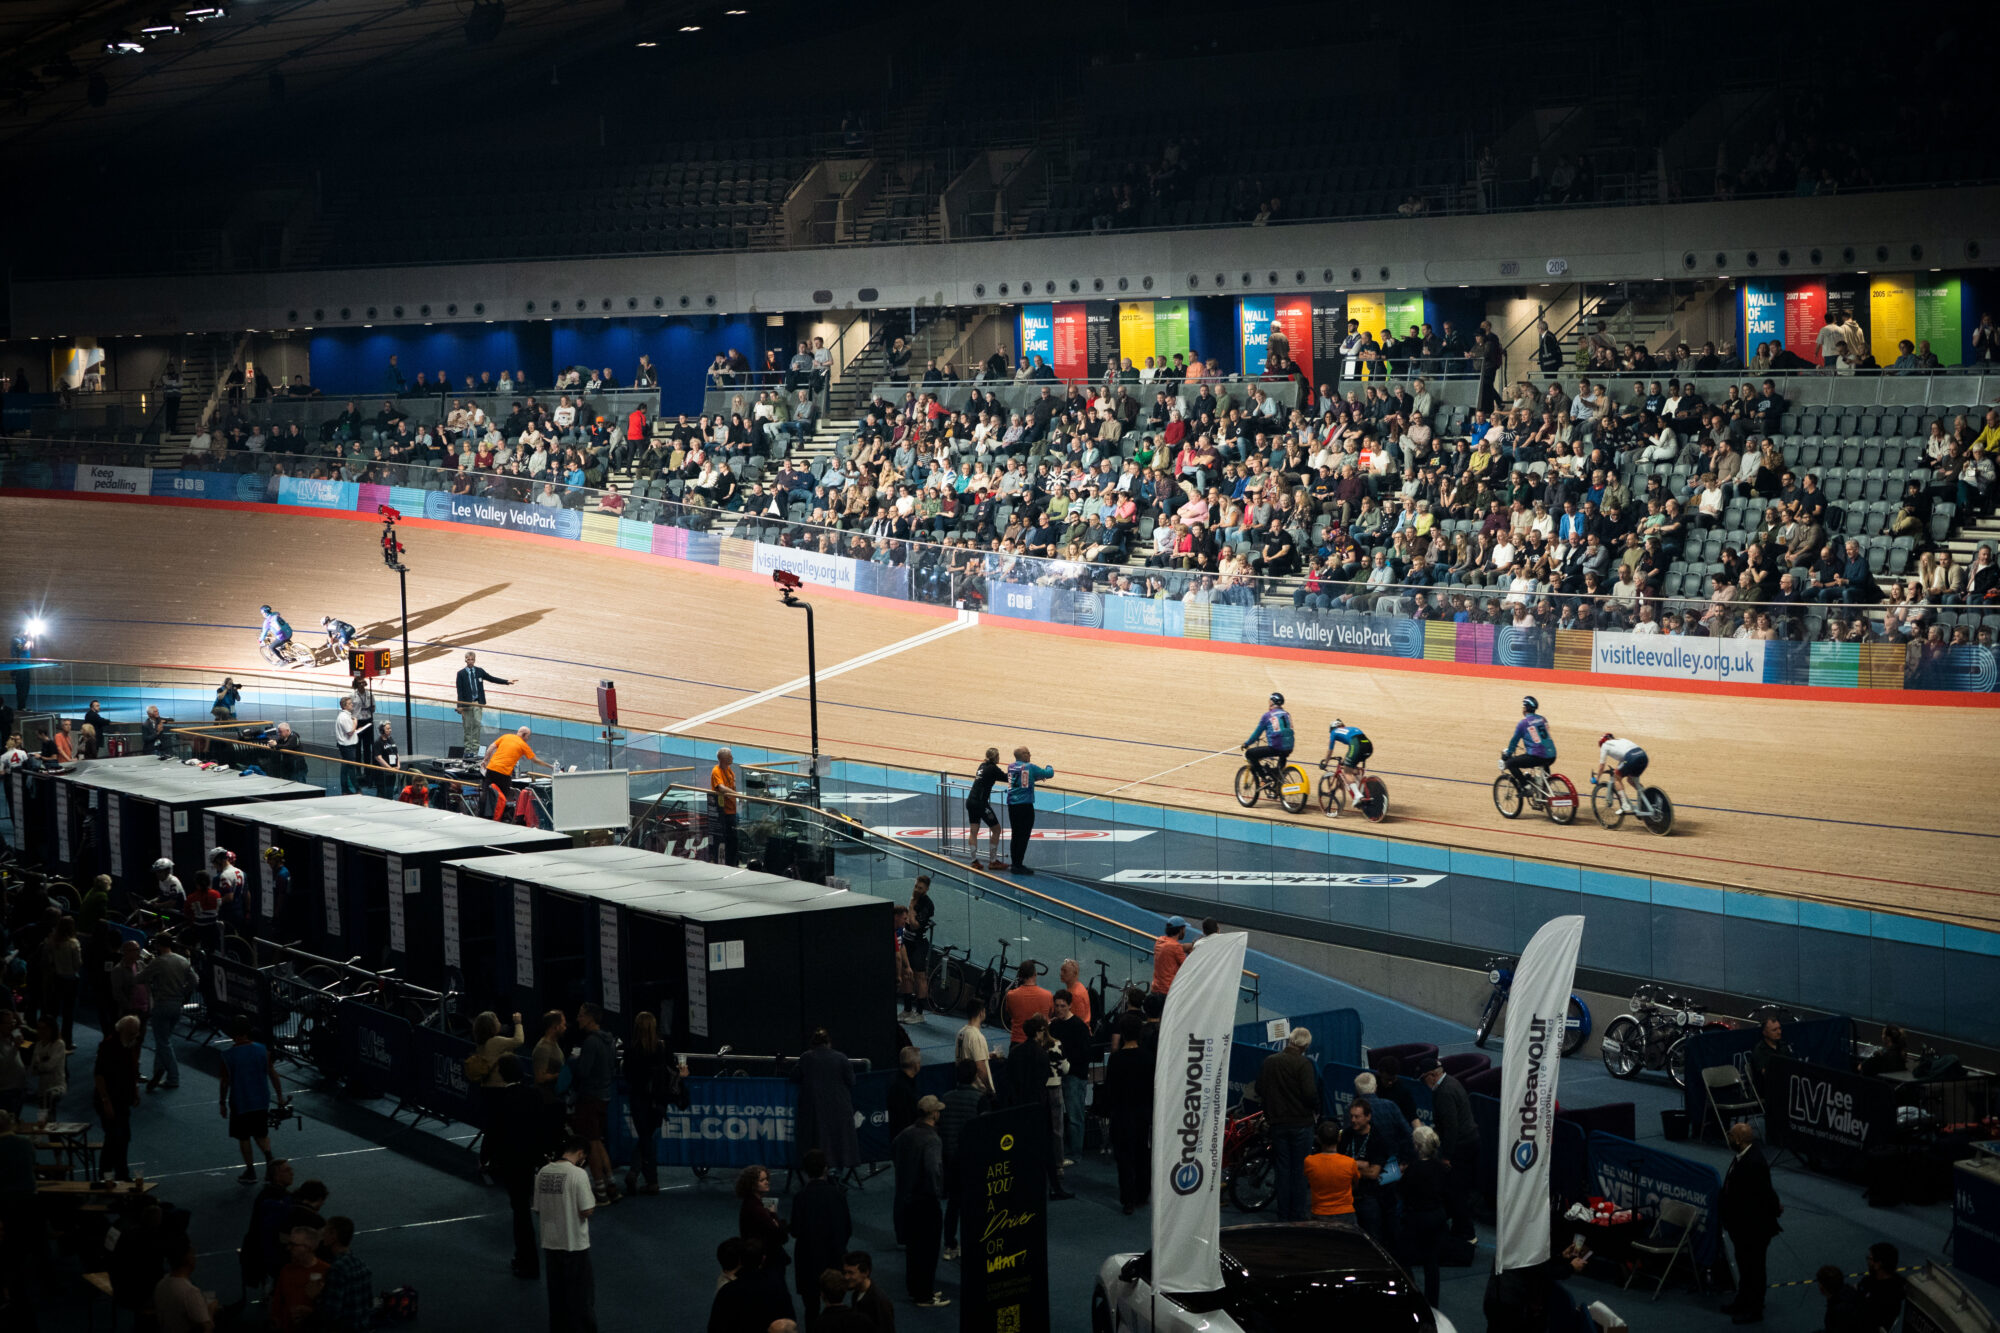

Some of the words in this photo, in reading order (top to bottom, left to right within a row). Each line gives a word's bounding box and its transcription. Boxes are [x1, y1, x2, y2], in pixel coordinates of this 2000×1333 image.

[1501, 263, 1517, 275] 207
[1549, 261, 1566, 273] 208
[1748, 294, 1777, 306] WALL
[1872, 290, 1886, 298] 2005
[1244, 311, 1269, 321] WALL
[1748, 308, 1761, 320] OF
[1024, 318, 1049, 328] WALL
[1244, 323, 1255, 334] OF
[1748, 321, 1776, 334] FAME
[1024, 330, 1036, 340] OF
[1244, 334, 1268, 345] FAME
[1025, 341, 1049, 351] FAME
[91, 467, 114, 479] Keep
[94, 478, 137, 492] pedalling
[318, 483, 333, 493] Lee
[318, 491, 340, 503] Valley
[451, 502, 471, 516] Lee
[473, 504, 507, 525] Valley
[510, 509, 556, 529] VeloPark
[758, 553, 850, 583] visitleevalley.org.uk
[1143, 613, 1163, 629] Valley
[1272, 620, 1294, 638] Lee
[1296, 622, 1333, 647] Valley
[1336, 625, 1392, 647] VeloPark
[355, 653, 365, 670] 19
[381, 651, 391, 668] 19
[1600, 644, 1755, 676] visitleevalley.org.uk
[1537, 725, 1548, 740] 5
[10, 752, 21, 763] 4
[1128, 872, 1417, 886] endeavour
[450, 1057, 463, 1076] Lee
[1203, 1037, 1214, 1081] limited
[1510, 1013, 1547, 1174] endeavour
[1788, 1074, 1827, 1125] LV
[1826, 1083, 1853, 1111] Lee
[714, 1105, 795, 1117] VELOPARK
[1169, 1033, 1206, 1196] endeavour
[1826, 1105, 1871, 1142] Valley
[986, 1160, 1011, 1179] ARE
[986, 1176, 1015, 1197] YOU
[1656, 1180, 1708, 1206] VELOPARK
[986, 1199, 996, 1214] A
[979, 1208, 1036, 1243] Driver
[986, 1238, 1005, 1255] OR
